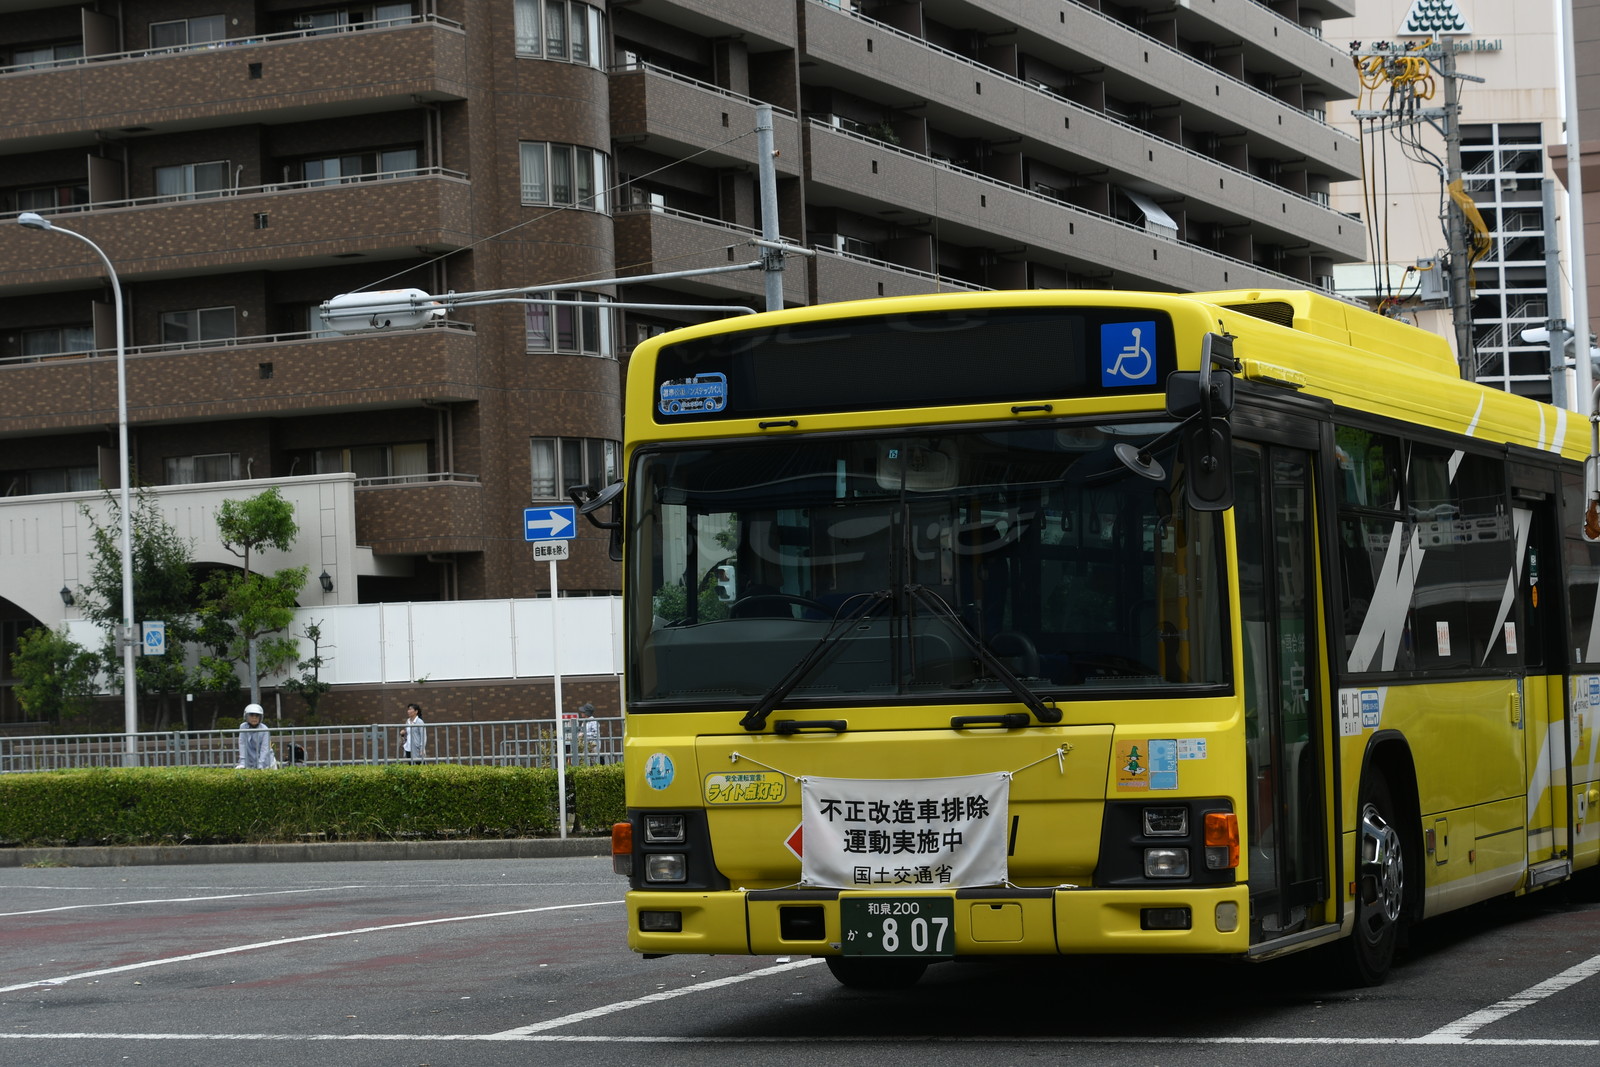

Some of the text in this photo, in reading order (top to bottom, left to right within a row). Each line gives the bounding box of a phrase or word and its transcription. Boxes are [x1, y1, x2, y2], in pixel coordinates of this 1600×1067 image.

[1421, 40, 1473, 52] Merial
[1477, 39, 1503, 51] Hall
[535, 545, 567, 557] 自転車を除く
[1341, 693, 1360, 719] 出口
[708, 782, 784, 801] ライト点灯中
[820, 795, 990, 824] 不正改造車排除
[843, 828, 963, 854] 運動実施中
[853, 864, 953, 885] 国土交通省
